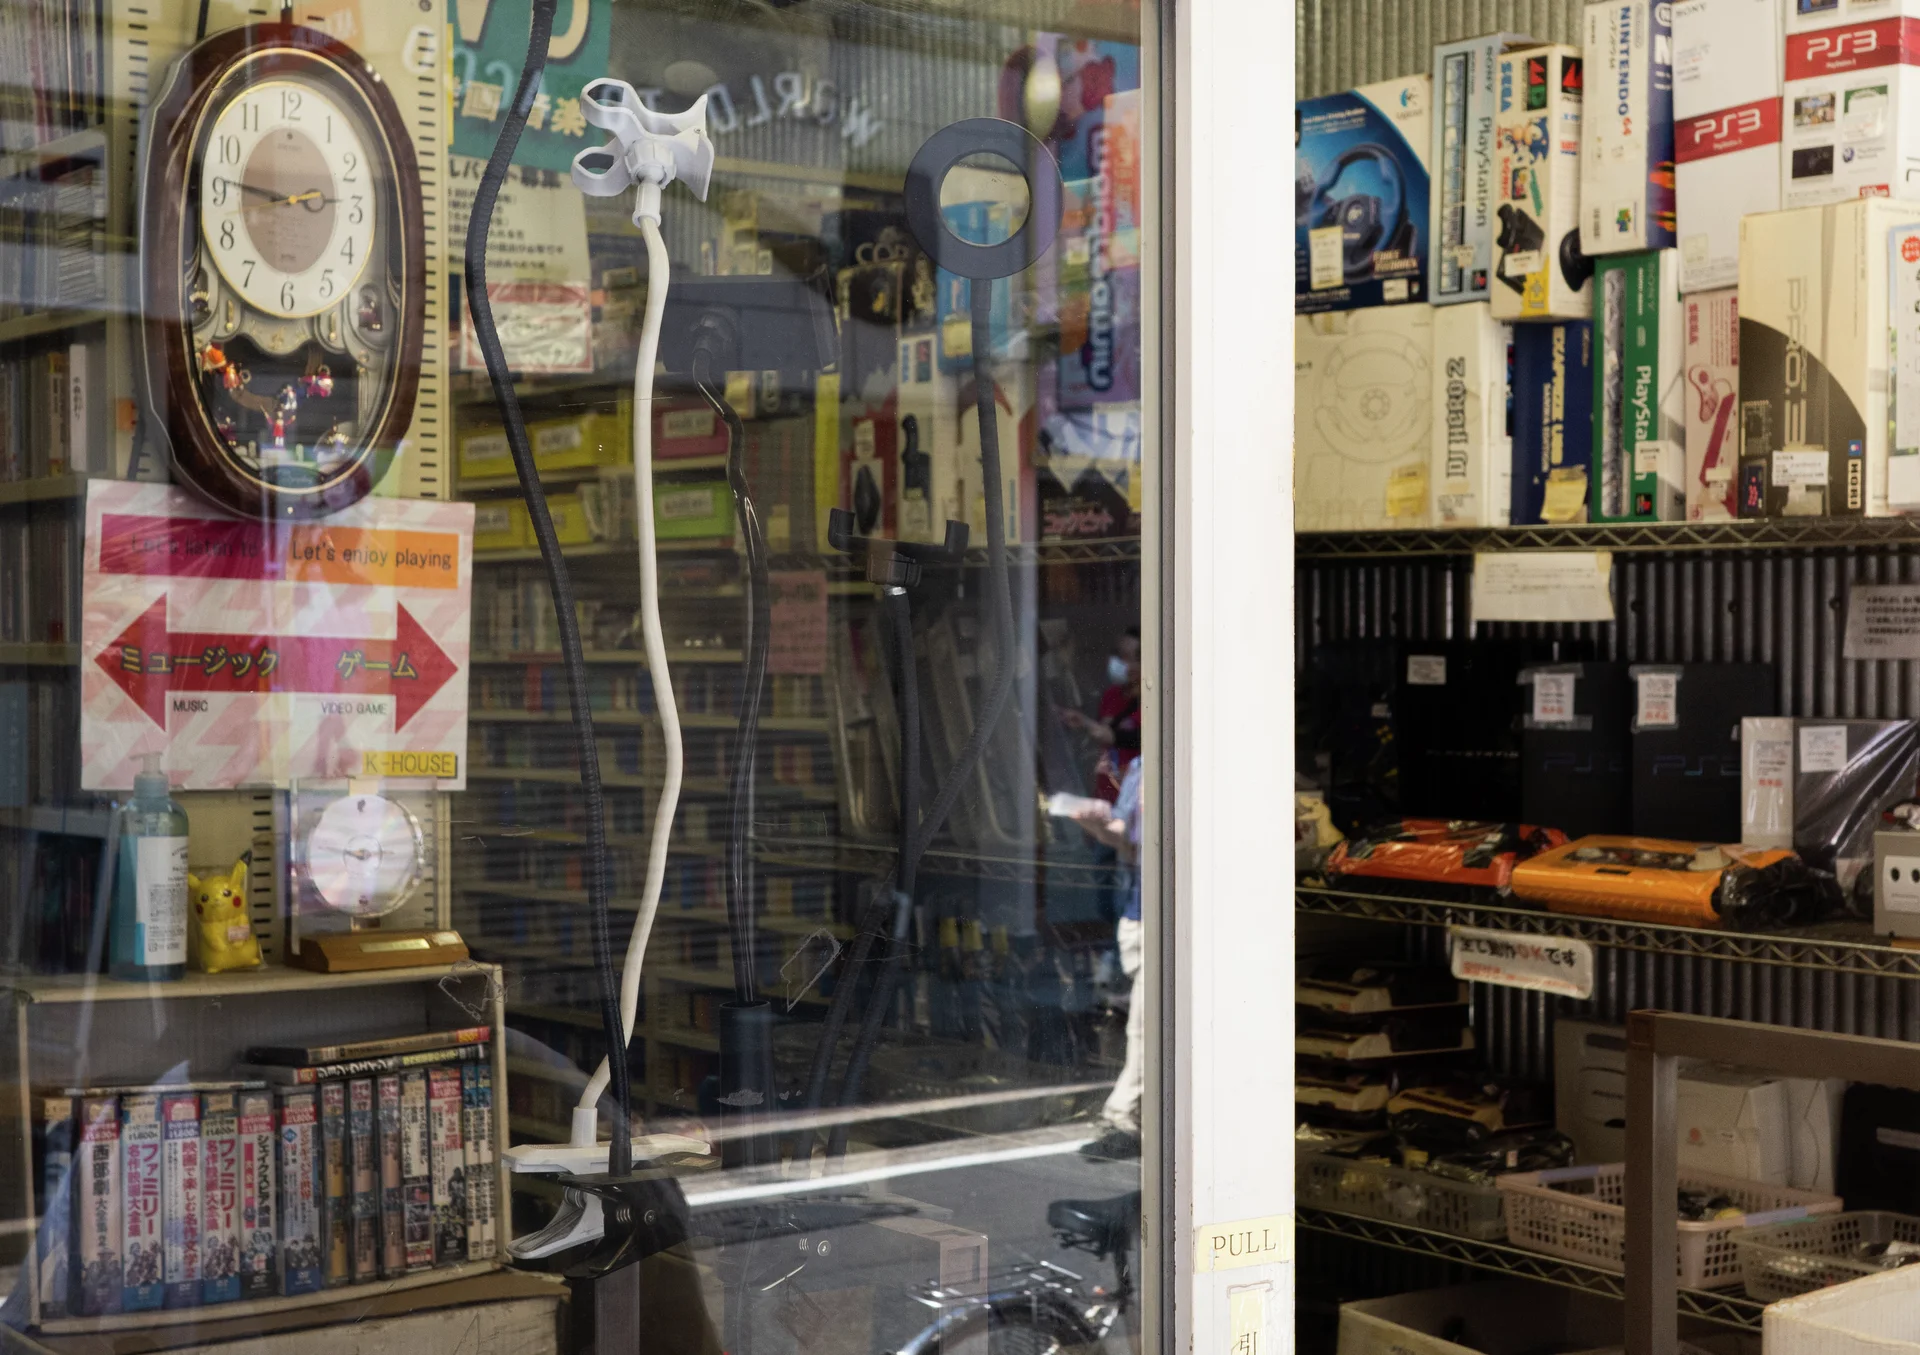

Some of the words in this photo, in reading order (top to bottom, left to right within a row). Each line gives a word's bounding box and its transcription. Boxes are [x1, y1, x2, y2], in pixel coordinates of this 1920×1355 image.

[1807, 28, 1878, 63] PS3
[1618, 6, 1632, 117] NINTENDO
[1500, 62, 1513, 113] SEGA
[241, 103, 261, 133] 11
[280, 90, 303, 122] 12
[324, 114, 334, 144] 1
[1622, 117, 1633, 137] 64
[1693, 107, 1762, 145] PS3
[218, 135, 241, 166] 10
[342, 152, 358, 183] 2
[1475, 115, 1494, 229] PlayStation
[212, 177, 230, 207] 9
[349, 194, 364, 225] 3
[220, 221, 235, 252] 8
[340, 236, 355, 265] 4
[241, 260, 256, 290] 7
[319, 269, 335, 298] 5
[280, 281, 296, 311] 6
[1631, 365, 1652, 481] PlayStan
[1849, 462, 1860, 507] HORI
[131, 535, 178, 556] Let's
[184, 537, 236, 558] listen
[292, 543, 336, 563] Let's
[341, 546, 388, 566] enjoy
[395, 546, 452, 572] playing
[119, 645, 280, 678] ミュージック
[335, 648, 419, 681] ゲーム
[173, 699, 209, 713] MUSIC
[321, 701, 353, 716] VIDEO
[356, 701, 388, 716] GAME
[141, 1142, 160, 1236] ファミリー
[219, 1137, 237, 1230] ファミリー
[1211, 1229, 1277, 1258] PULL
